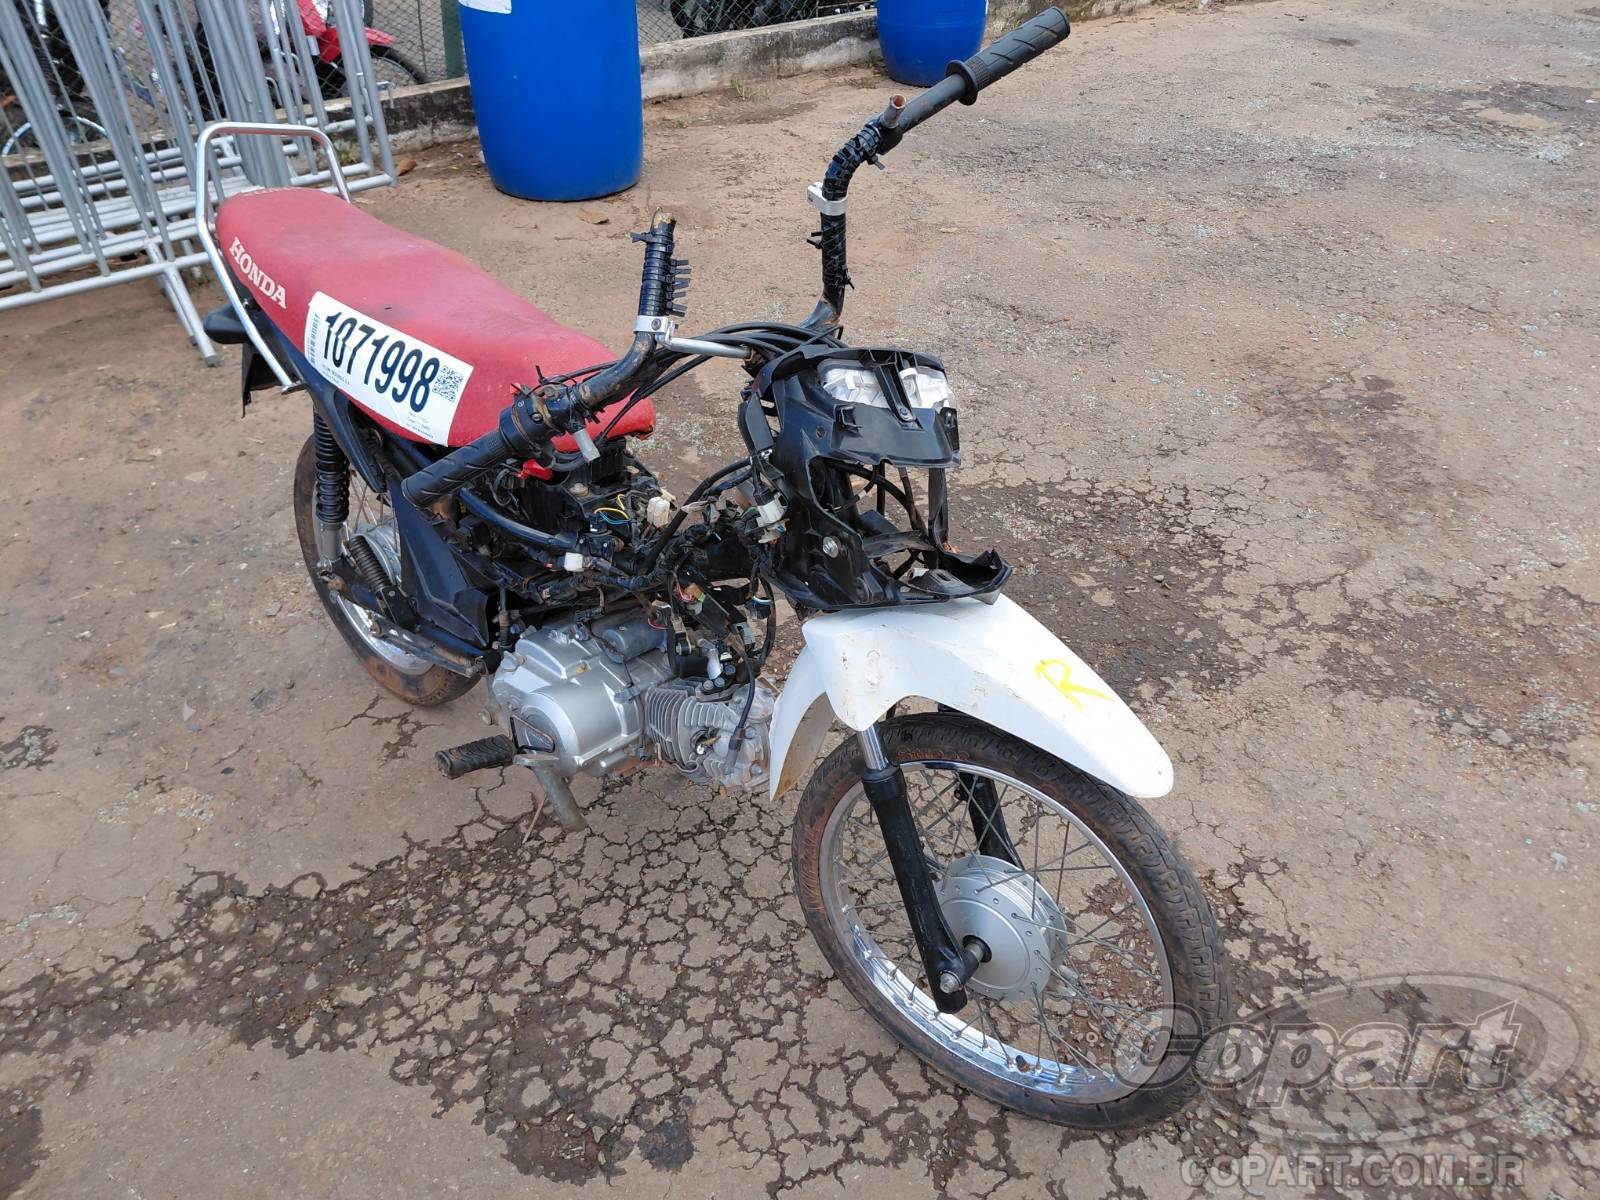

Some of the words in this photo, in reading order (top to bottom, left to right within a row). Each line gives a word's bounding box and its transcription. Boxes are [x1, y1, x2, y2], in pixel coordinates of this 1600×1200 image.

[229, 238, 287, 309] HONDA
[324, 312, 440, 412] 1071998
[1036, 659, 1113, 710] R
